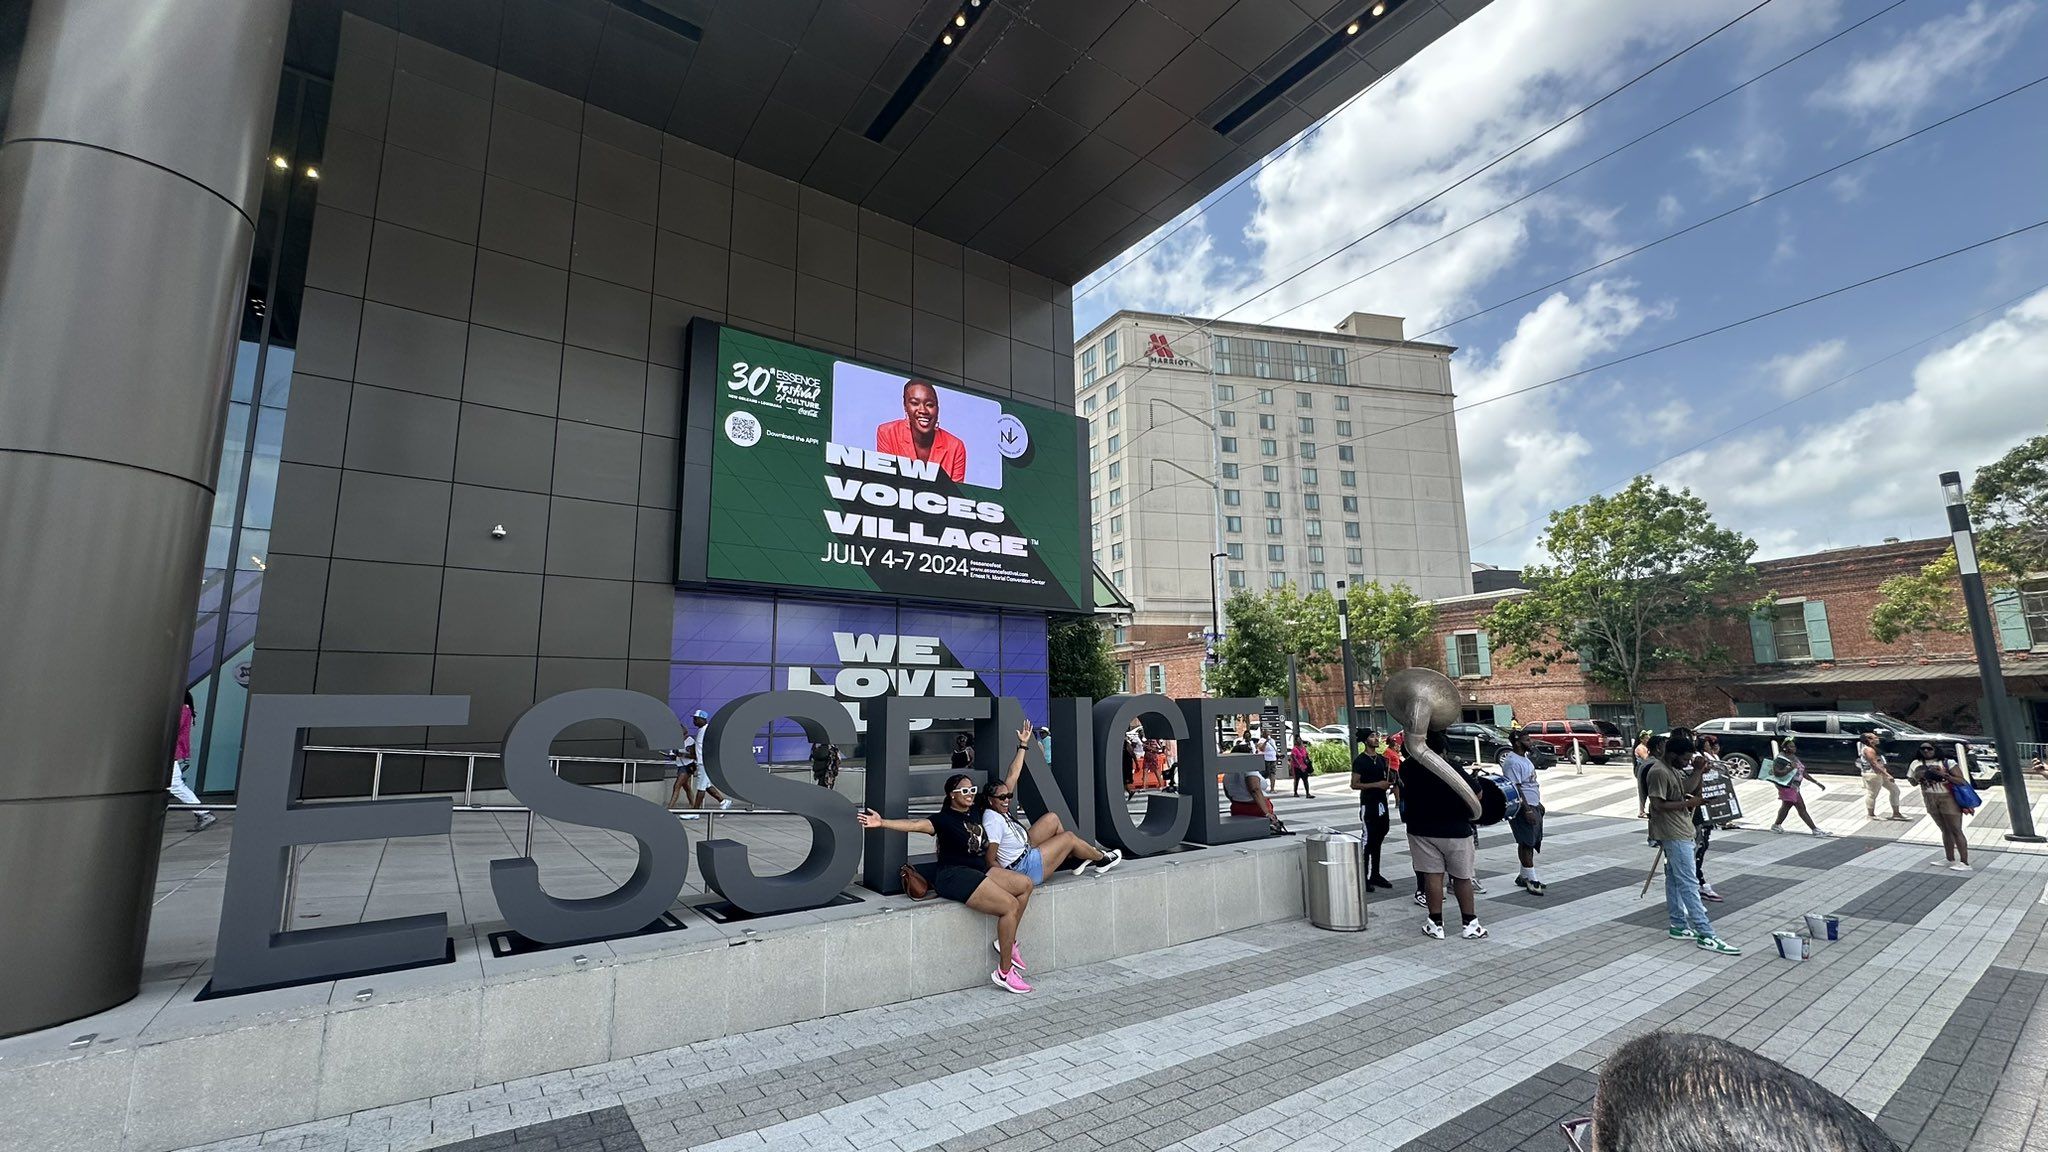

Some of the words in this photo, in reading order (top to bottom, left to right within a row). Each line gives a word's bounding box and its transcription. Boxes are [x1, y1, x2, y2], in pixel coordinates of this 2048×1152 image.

[775, 381, 821, 402] Festival
[776, 369, 821, 389] ESSENCE
[786, 397, 821, 410] CULTURE
[766, 429, 795, 441] Download
[795, 435, 806, 443] the
[825, 441, 941, 482] NEW
[824, 475, 1005, 524] VOICES
[823, 509, 1029, 557] VILLAGE
[821, 542, 877, 567] JULY
[880, 549, 915, 571] 4-7
[918, 553, 969, 577] 2024
[832, 631, 940, 665] WE
[787, 666, 975, 698] LOVE
[211, 688, 1271, 992] ESSENCE
